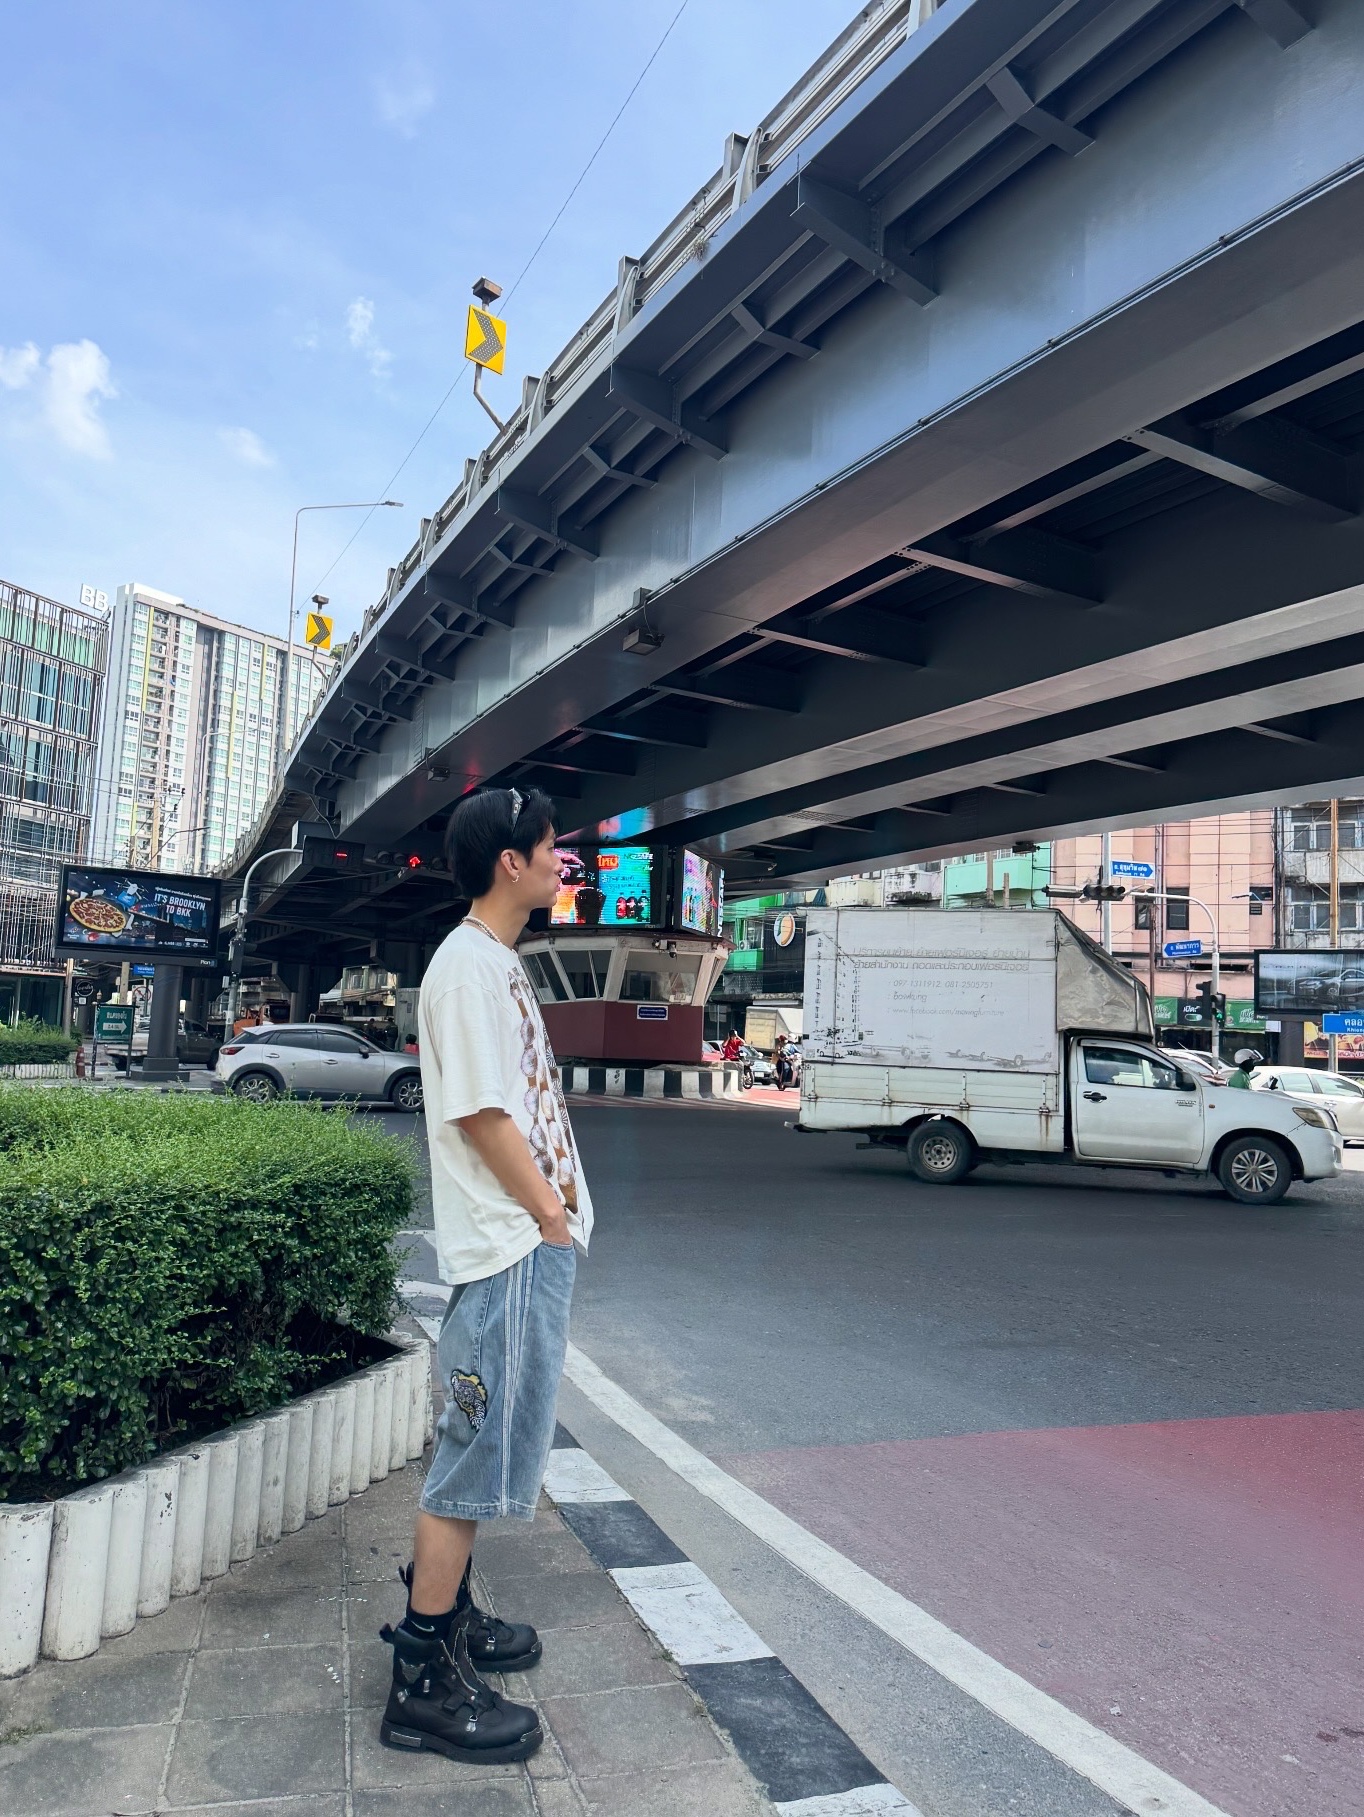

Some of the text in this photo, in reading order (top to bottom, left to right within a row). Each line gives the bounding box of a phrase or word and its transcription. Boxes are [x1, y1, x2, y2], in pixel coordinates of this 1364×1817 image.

[154, 893, 168, 904] IT'S
[169, 896, 206, 911] BROOKLYN
[166, 905, 191, 918] TO BKK
[1344, 1018, 1364, 1027] คลอ
